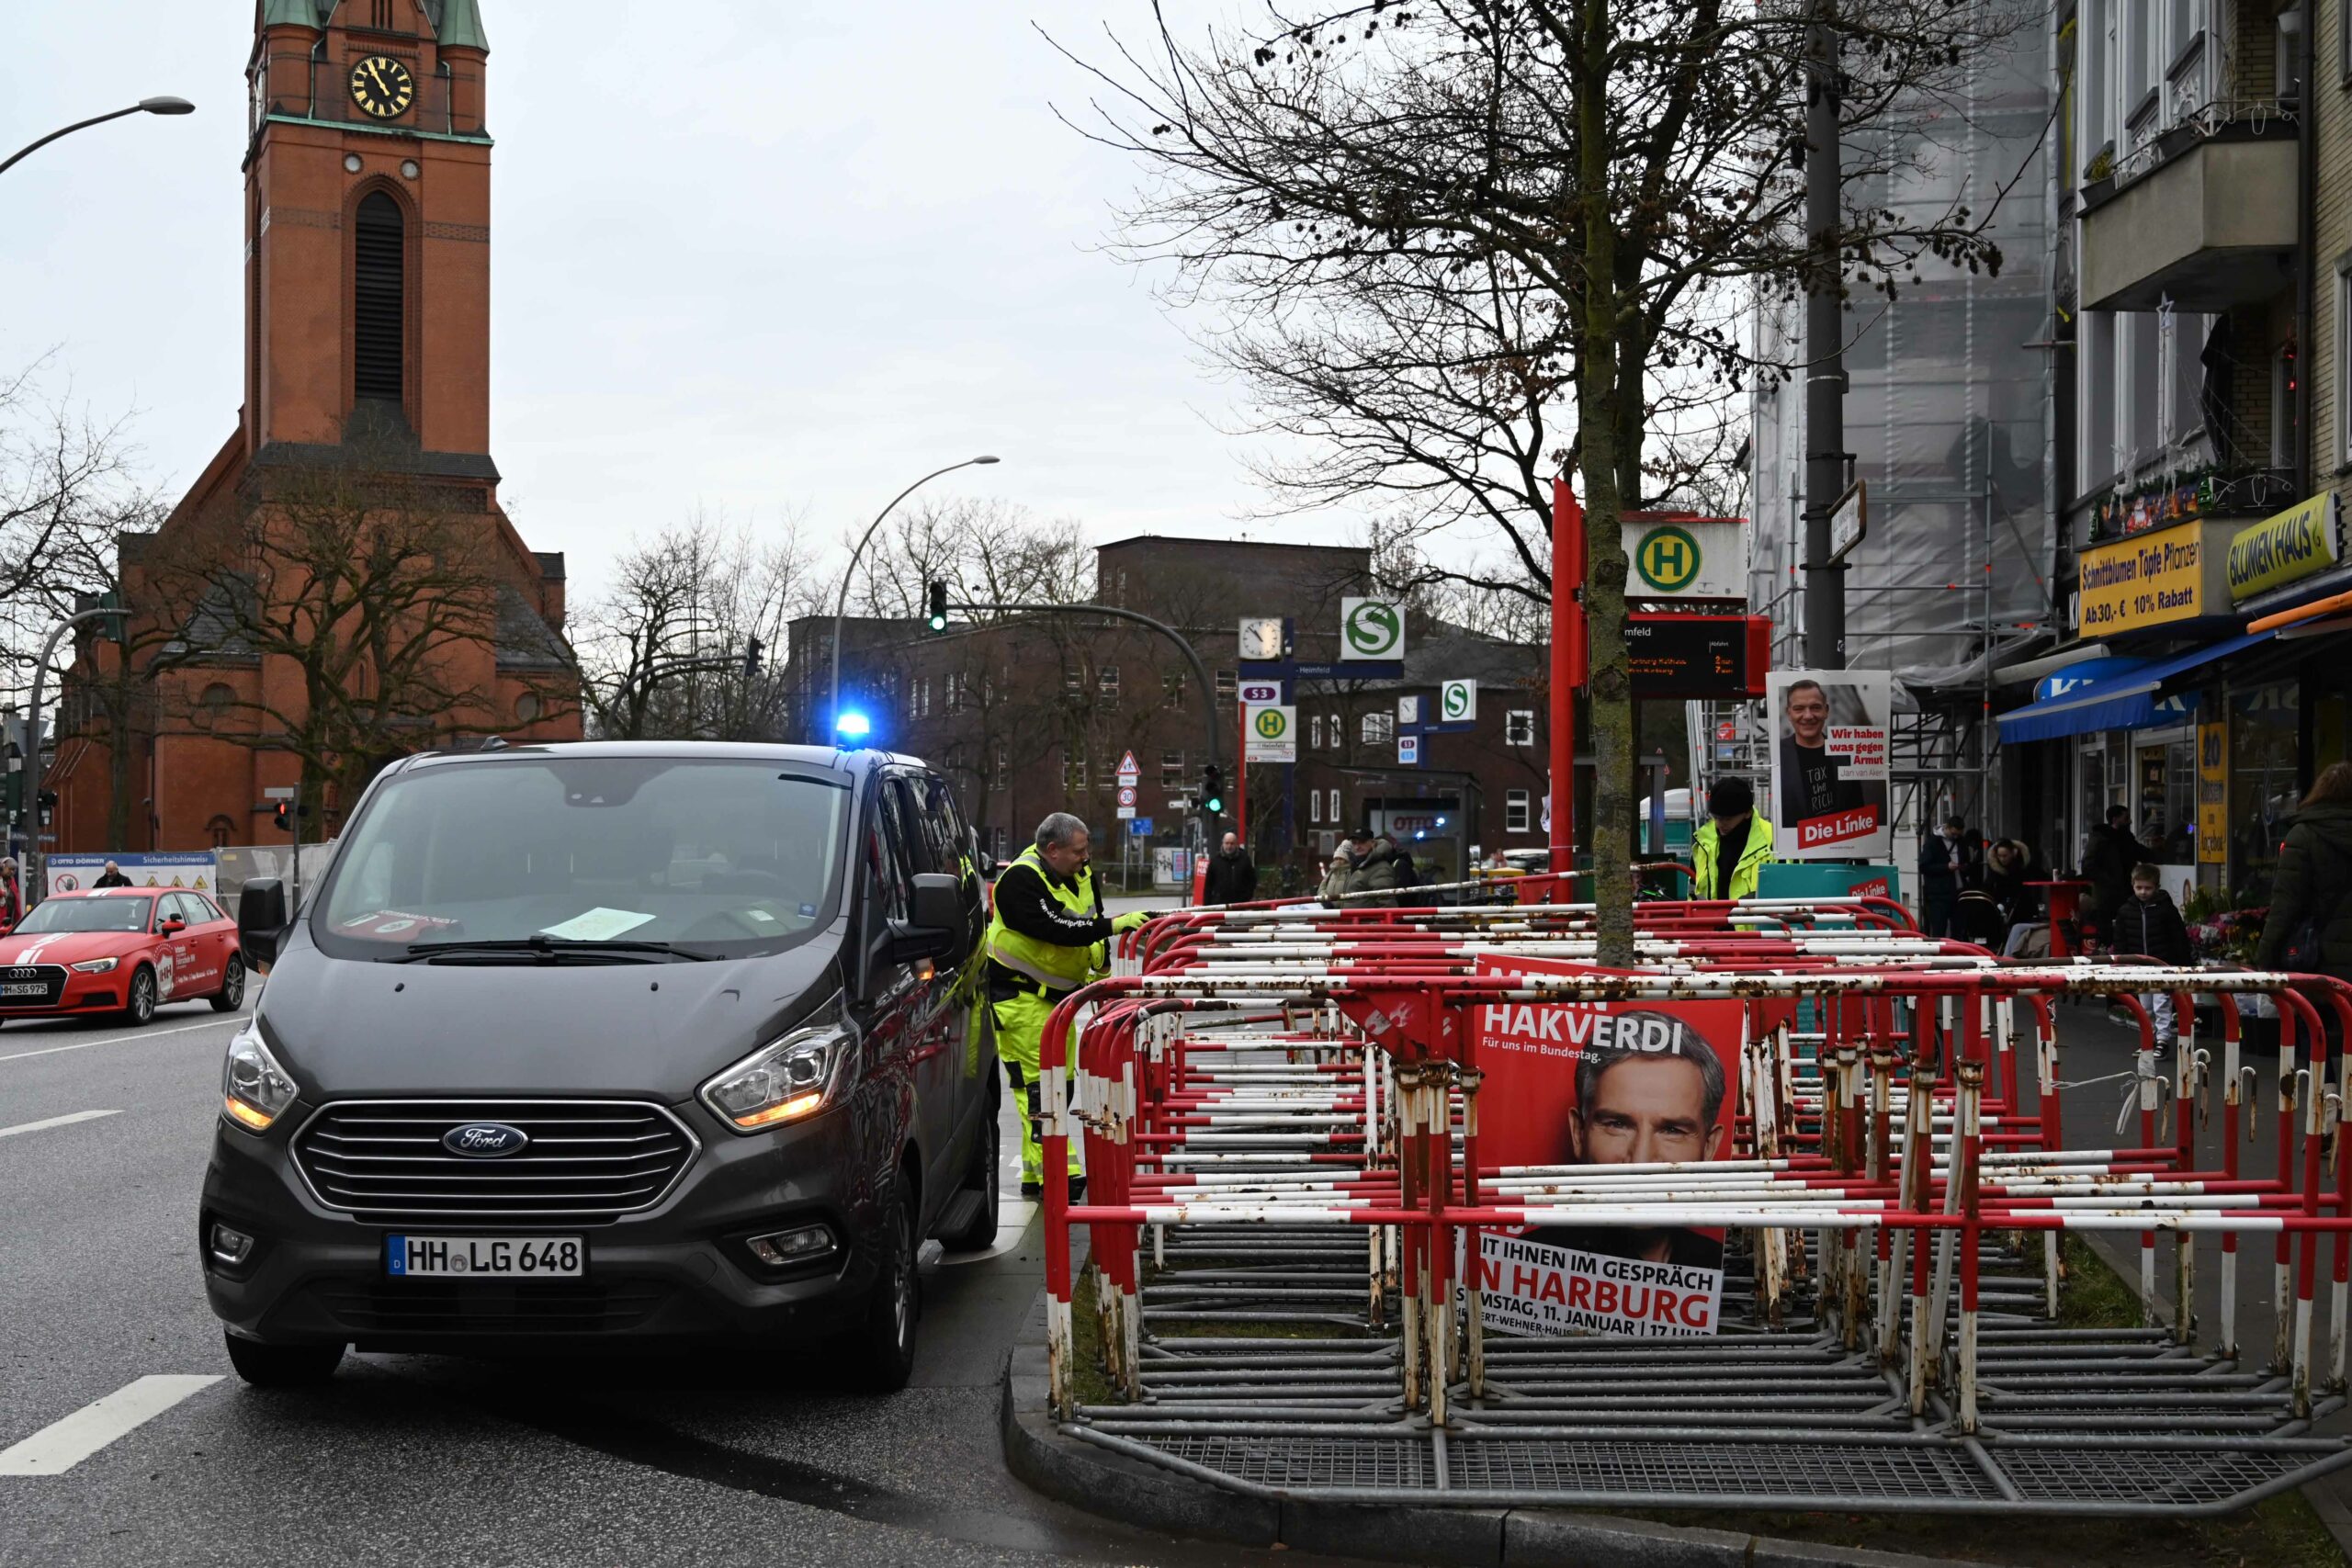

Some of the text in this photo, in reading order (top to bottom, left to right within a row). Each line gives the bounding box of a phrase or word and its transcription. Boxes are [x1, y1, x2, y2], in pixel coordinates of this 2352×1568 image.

[1654, 542, 1682, 577] H
[2229, 510, 2312, 586] BLUMEN HAUS
[2082, 542, 2200, 592] Schnittblumen Töpfe Pflanzen
[2085, 606, 2098, 625] Ab
[2120, 600, 2126, 617] €
[2133, 593, 2155, 615] 10%
[2158, 585, 2193, 610] Rabatt
[1829, 742, 1883, 754] was gegen
[1831, 728, 1883, 739] Wir haben
[1840, 769, 1855, 777] Jan
[1869, 769, 1883, 777] Aken
[1853, 755, 1883, 765] Armut
[1122, 792, 1133, 802] 30
[1804, 815, 1873, 842] Die Linke
[17, 985, 28, 994] SG
[29, 985, 47, 994] 975
[1483, 1003, 1683, 1055] HAKVERDI
[1482, 1036, 1601, 1064] Für uns im Bundestag.
[460, 1128, 507, 1148] Ford
[408, 1240, 448, 1271] HH
[469, 1242, 512, 1272] LG
[518, 1241, 579, 1272] 648
[1503, 1240, 1566, 1269] IHNEN
[1570, 1254, 1597, 1275] IM
[1602, 1259, 1713, 1292] GESPRÄCH
[1512, 1264, 1711, 1328] HARBURG
[1456, 1287, 1538, 1320] SMSTAG,
[1543, 1304, 1561, 1322] 11.
[1565, 1309, 1635, 1336] JANUAR
